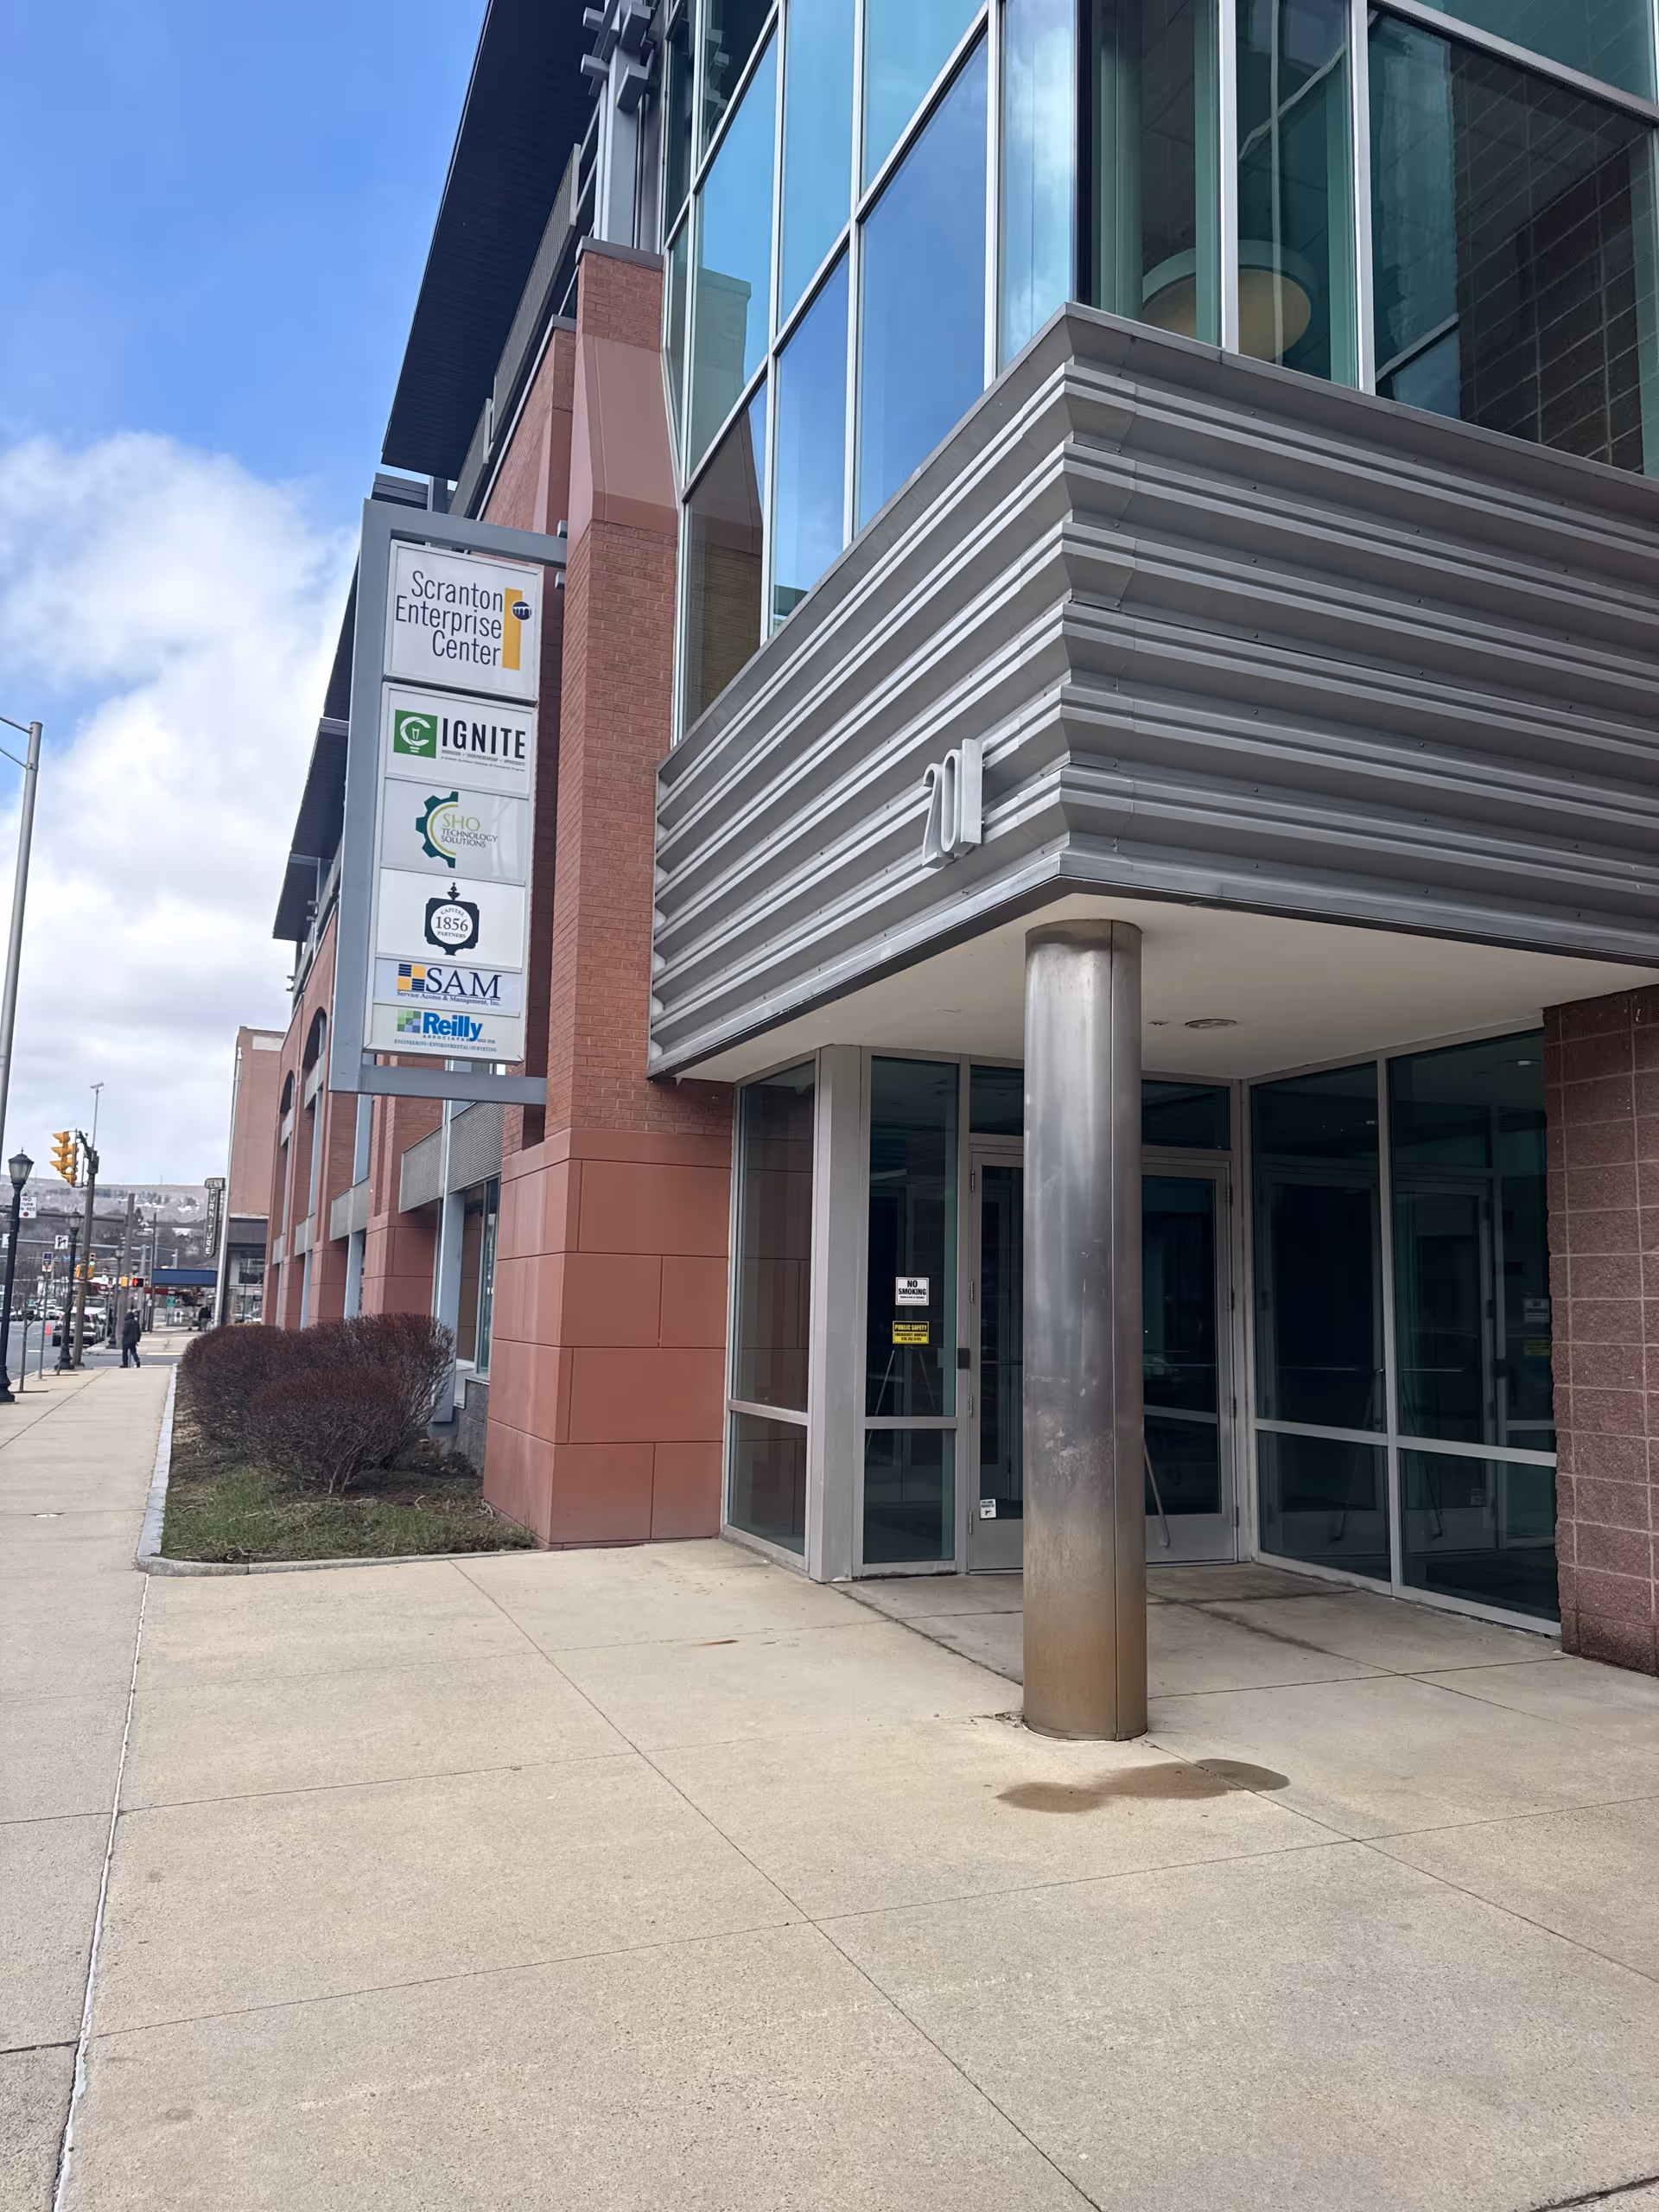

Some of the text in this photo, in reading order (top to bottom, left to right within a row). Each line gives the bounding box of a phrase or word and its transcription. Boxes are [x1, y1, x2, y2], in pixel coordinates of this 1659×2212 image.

[411, 570, 504, 613] Scranton
[395, 594, 502, 639] Enterprise
[432, 630, 501, 666] Center
[442, 717, 526, 760] IGNITE
[442, 813, 481, 832] SHO
[441, 828, 499, 842] TECHNOLOGY
[441, 835, 486, 849] SOLUTIONS
[435, 916, 469, 932] 1856
[440, 907, 465, 918] CAPITAL
[437, 931, 467, 939] PARTNERS
[397, 990, 419, 999] Service
[426, 967, 503, 1000] SAM
[423, 1012, 484, 1042] Reilly
[205, 1189, 216, 1254] FURNITURE
